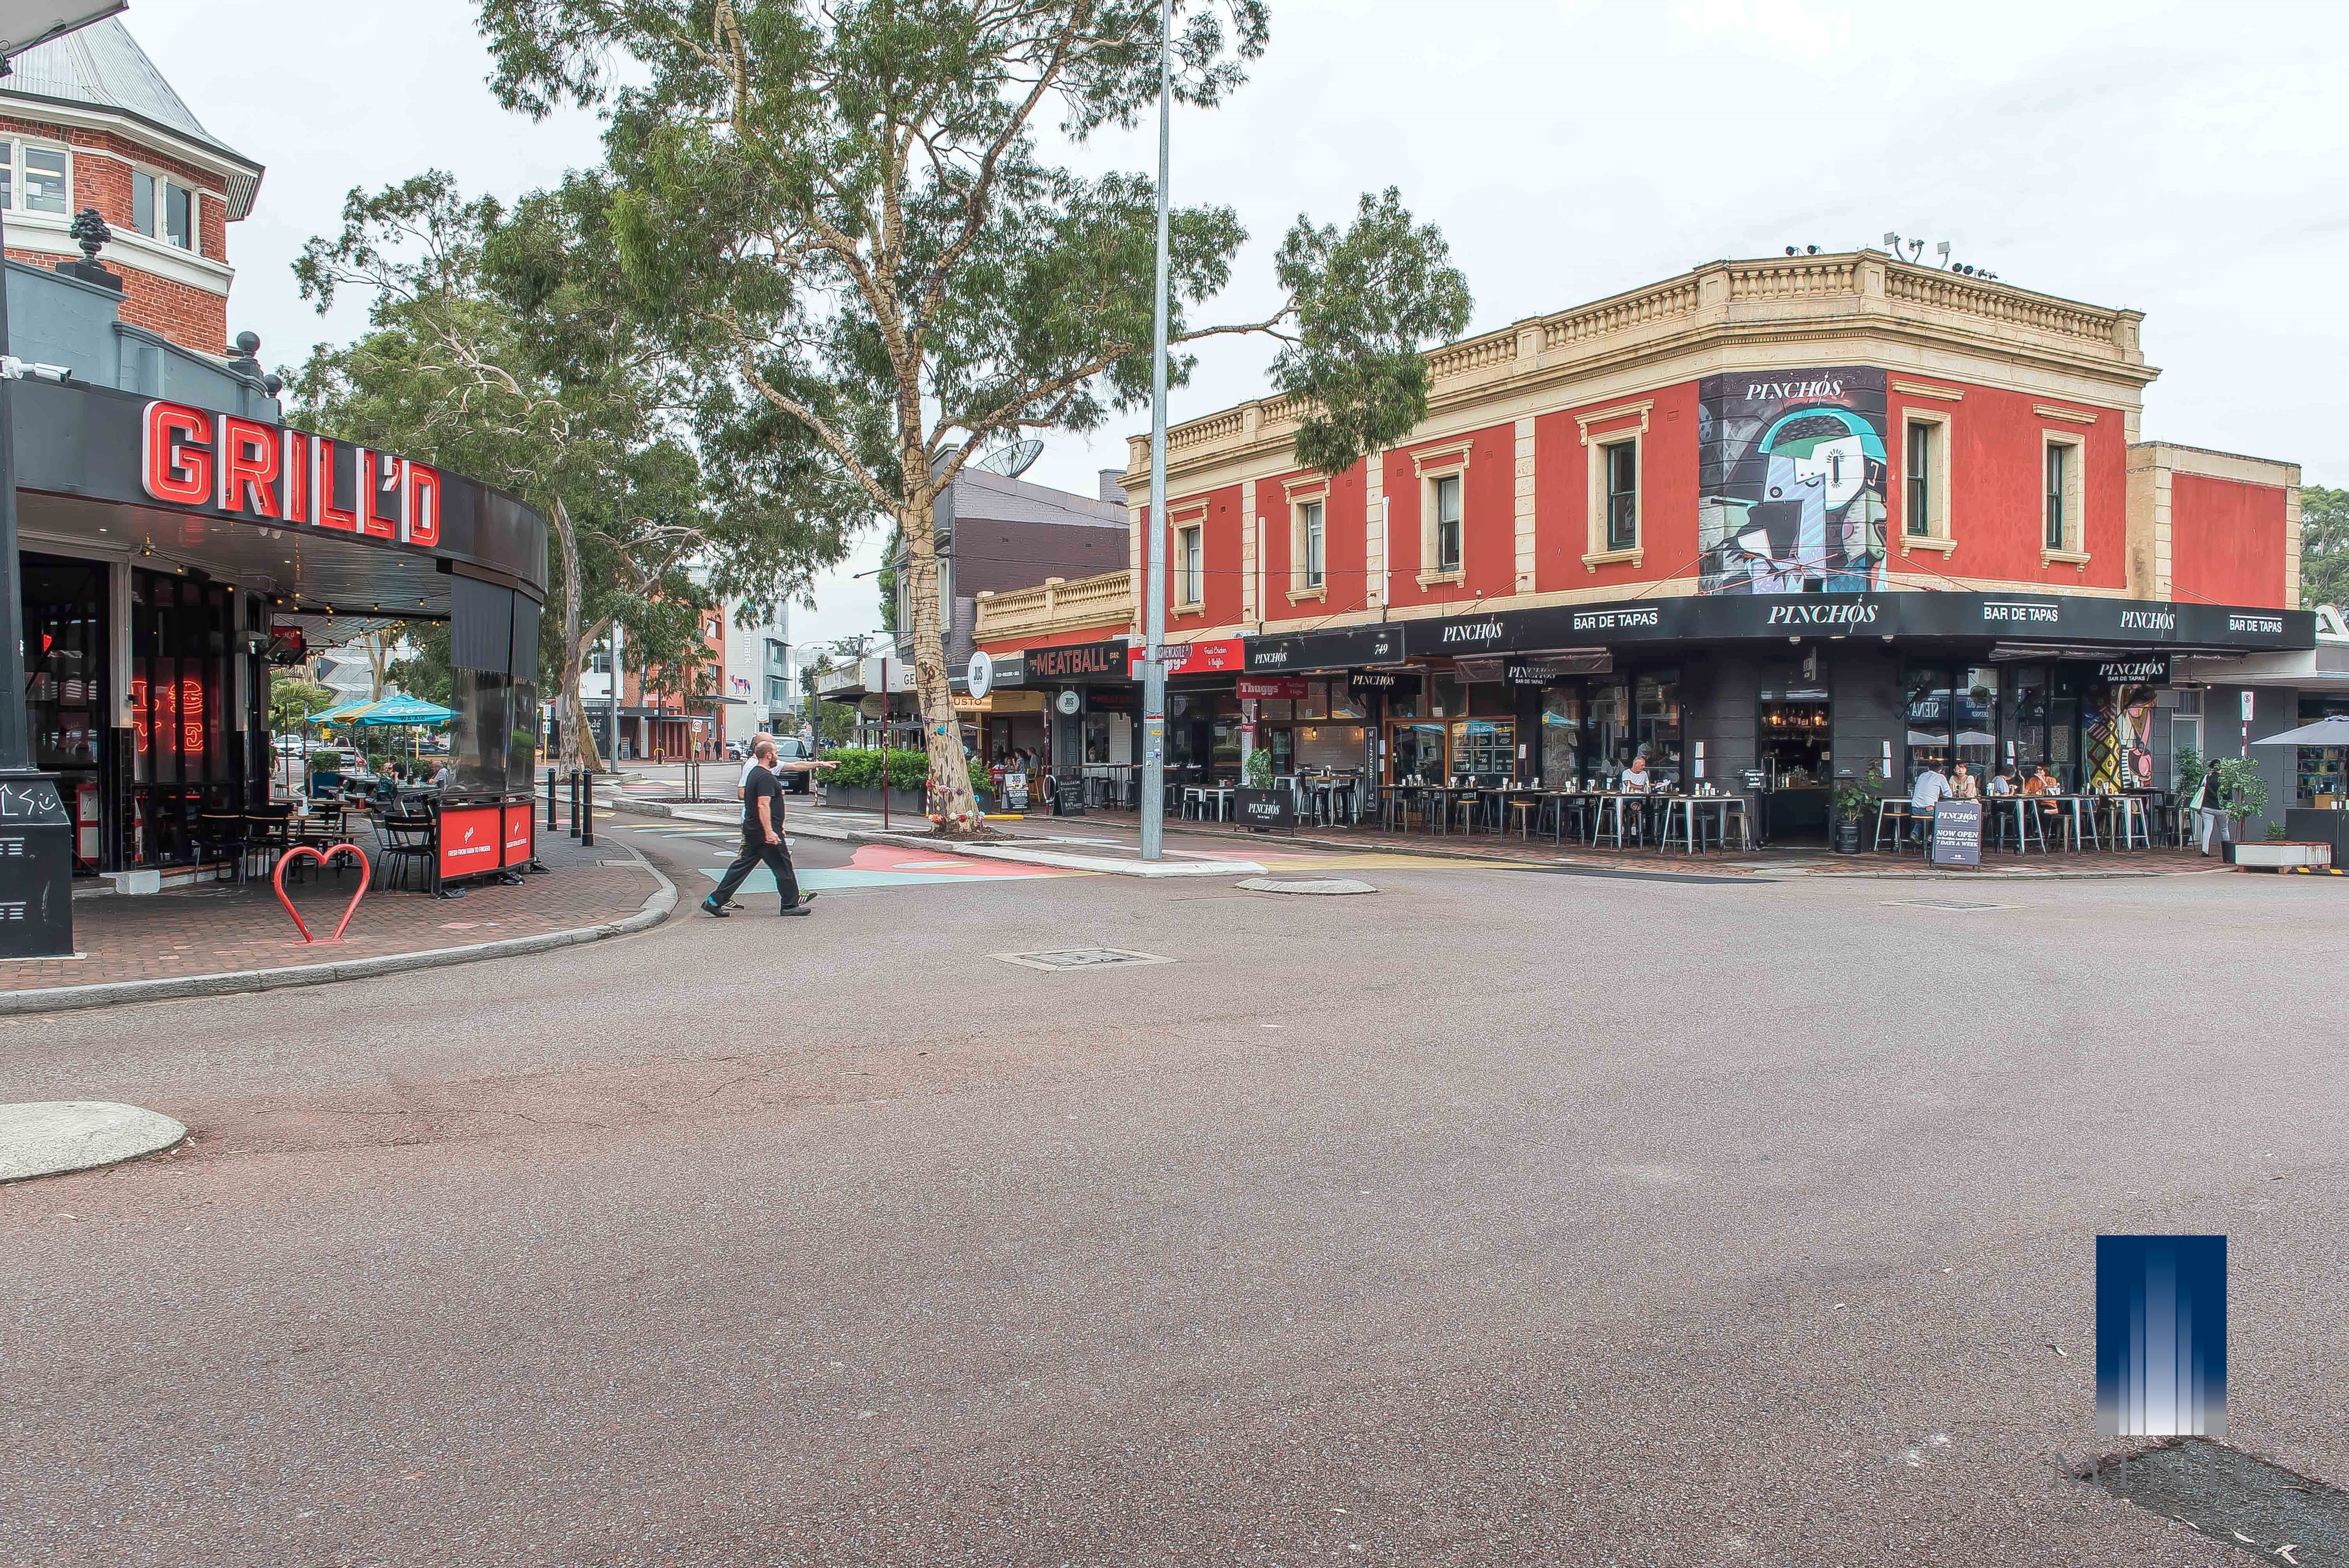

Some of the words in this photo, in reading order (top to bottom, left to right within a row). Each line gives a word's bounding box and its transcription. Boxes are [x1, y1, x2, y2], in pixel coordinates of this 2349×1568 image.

[1574, 617, 1596, 630] BAR
[1599, 616, 1615, 628] DE
[1618, 612, 1658, 627] TAPAS
[1984, 607, 2009, 620] BAR
[2011, 607, 2026, 621] DE
[2028, 608, 2058, 622] TAPAS
[2229, 619, 2246, 632] BAR
[2247, 620, 2258, 633] DE
[2259, 620, 2282, 634] TAPAS
[1163, 645, 1185, 658] NEWCASTLE
[1374, 643, 1388, 656] 749
[1037, 647, 1108, 676] MEATBALL
[973, 666, 983, 681] JUS
[1240, 682, 1278, 695] Thuggs
